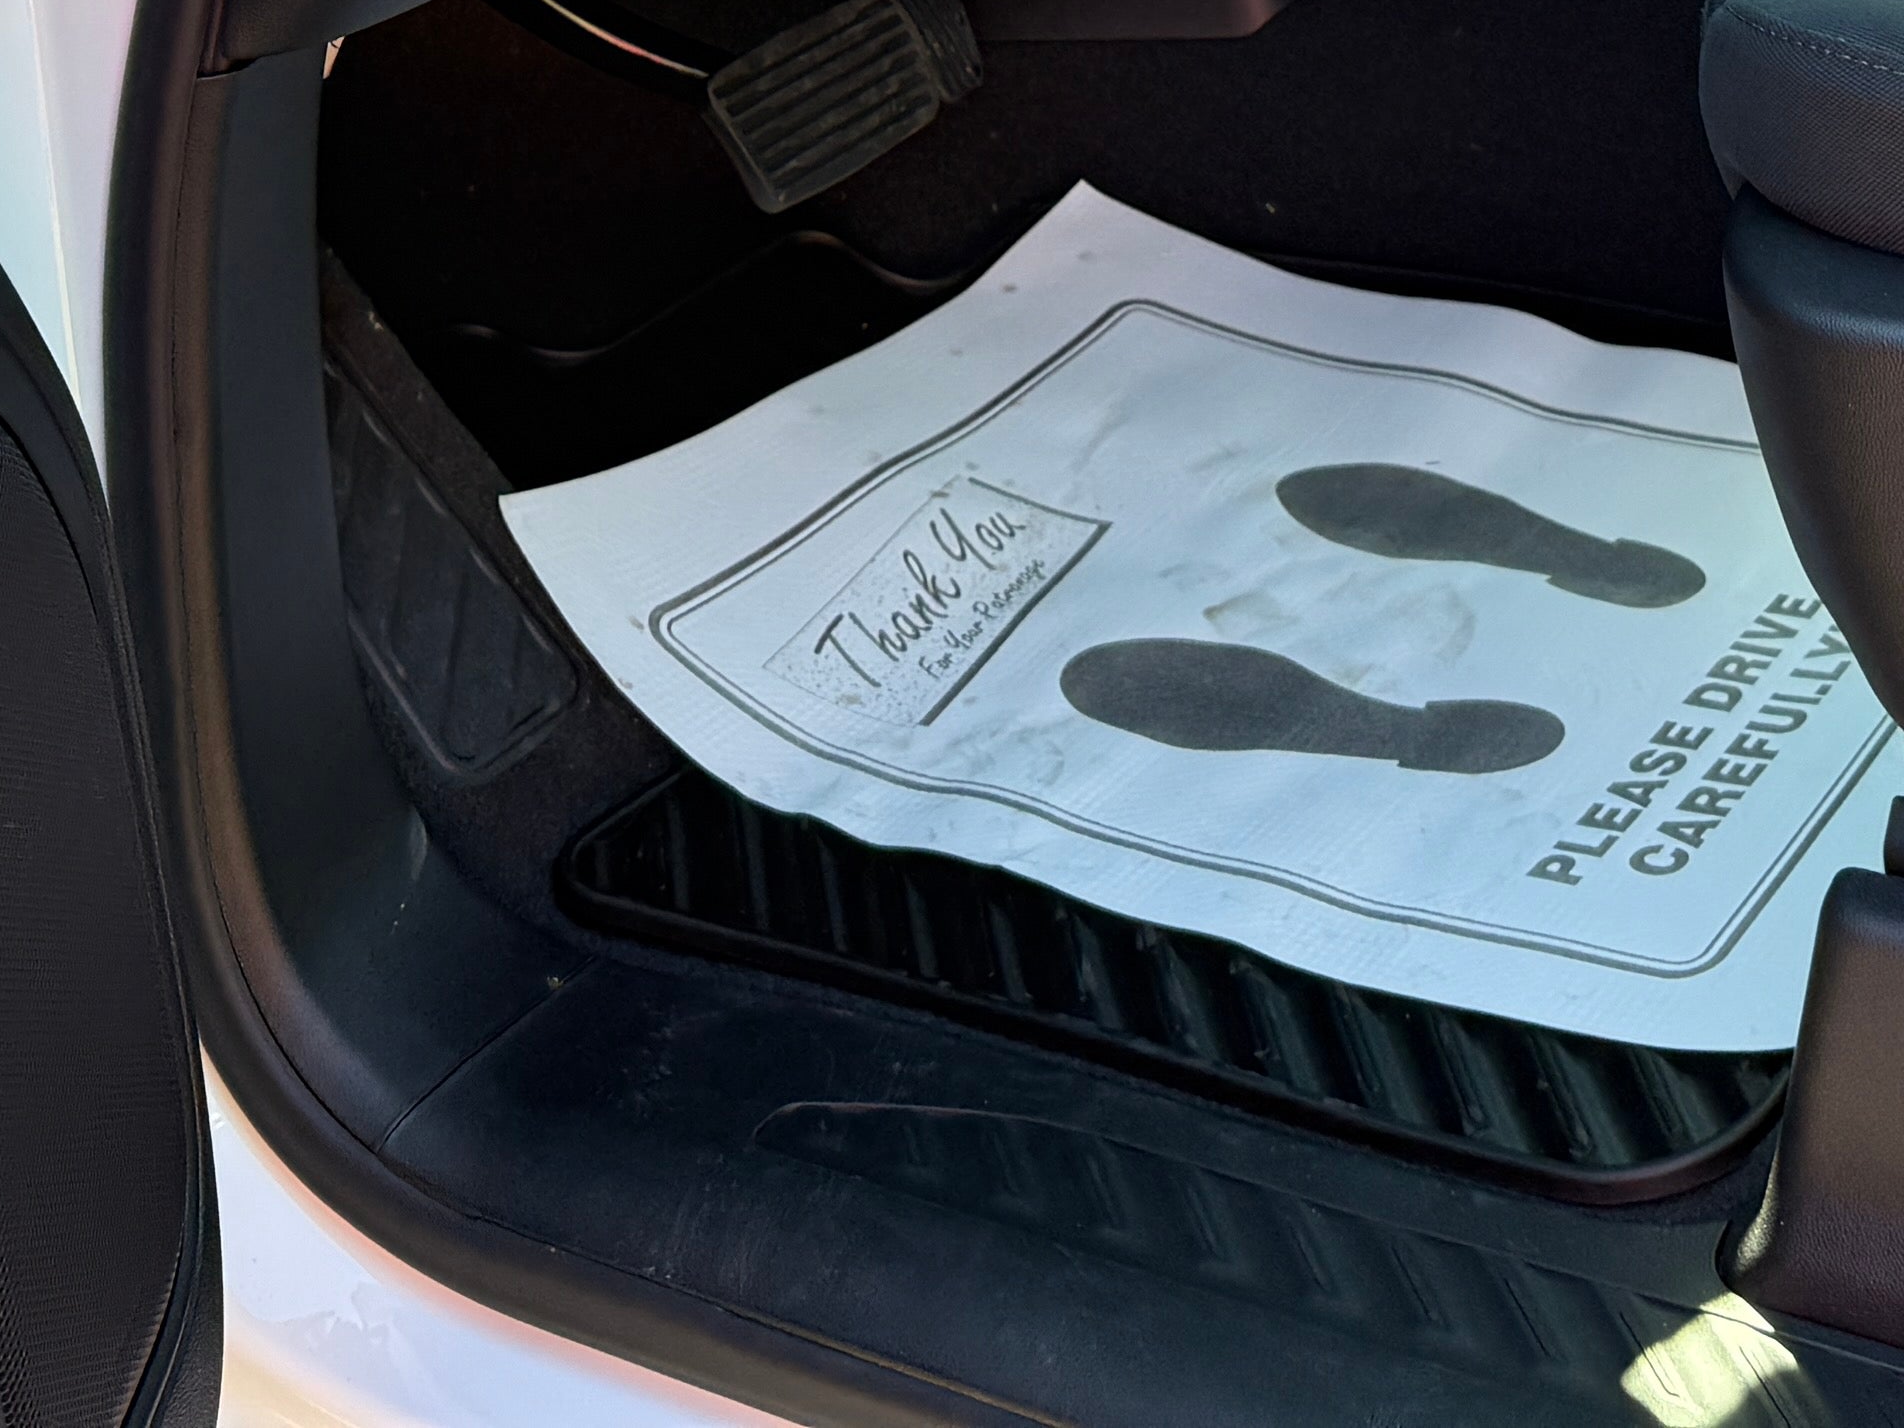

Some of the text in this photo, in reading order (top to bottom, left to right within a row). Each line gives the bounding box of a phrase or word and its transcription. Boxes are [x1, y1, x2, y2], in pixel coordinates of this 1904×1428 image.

[814, 507, 1027, 687] Thank You
[1525, 593, 1822, 886] PLEASE DRIVE
